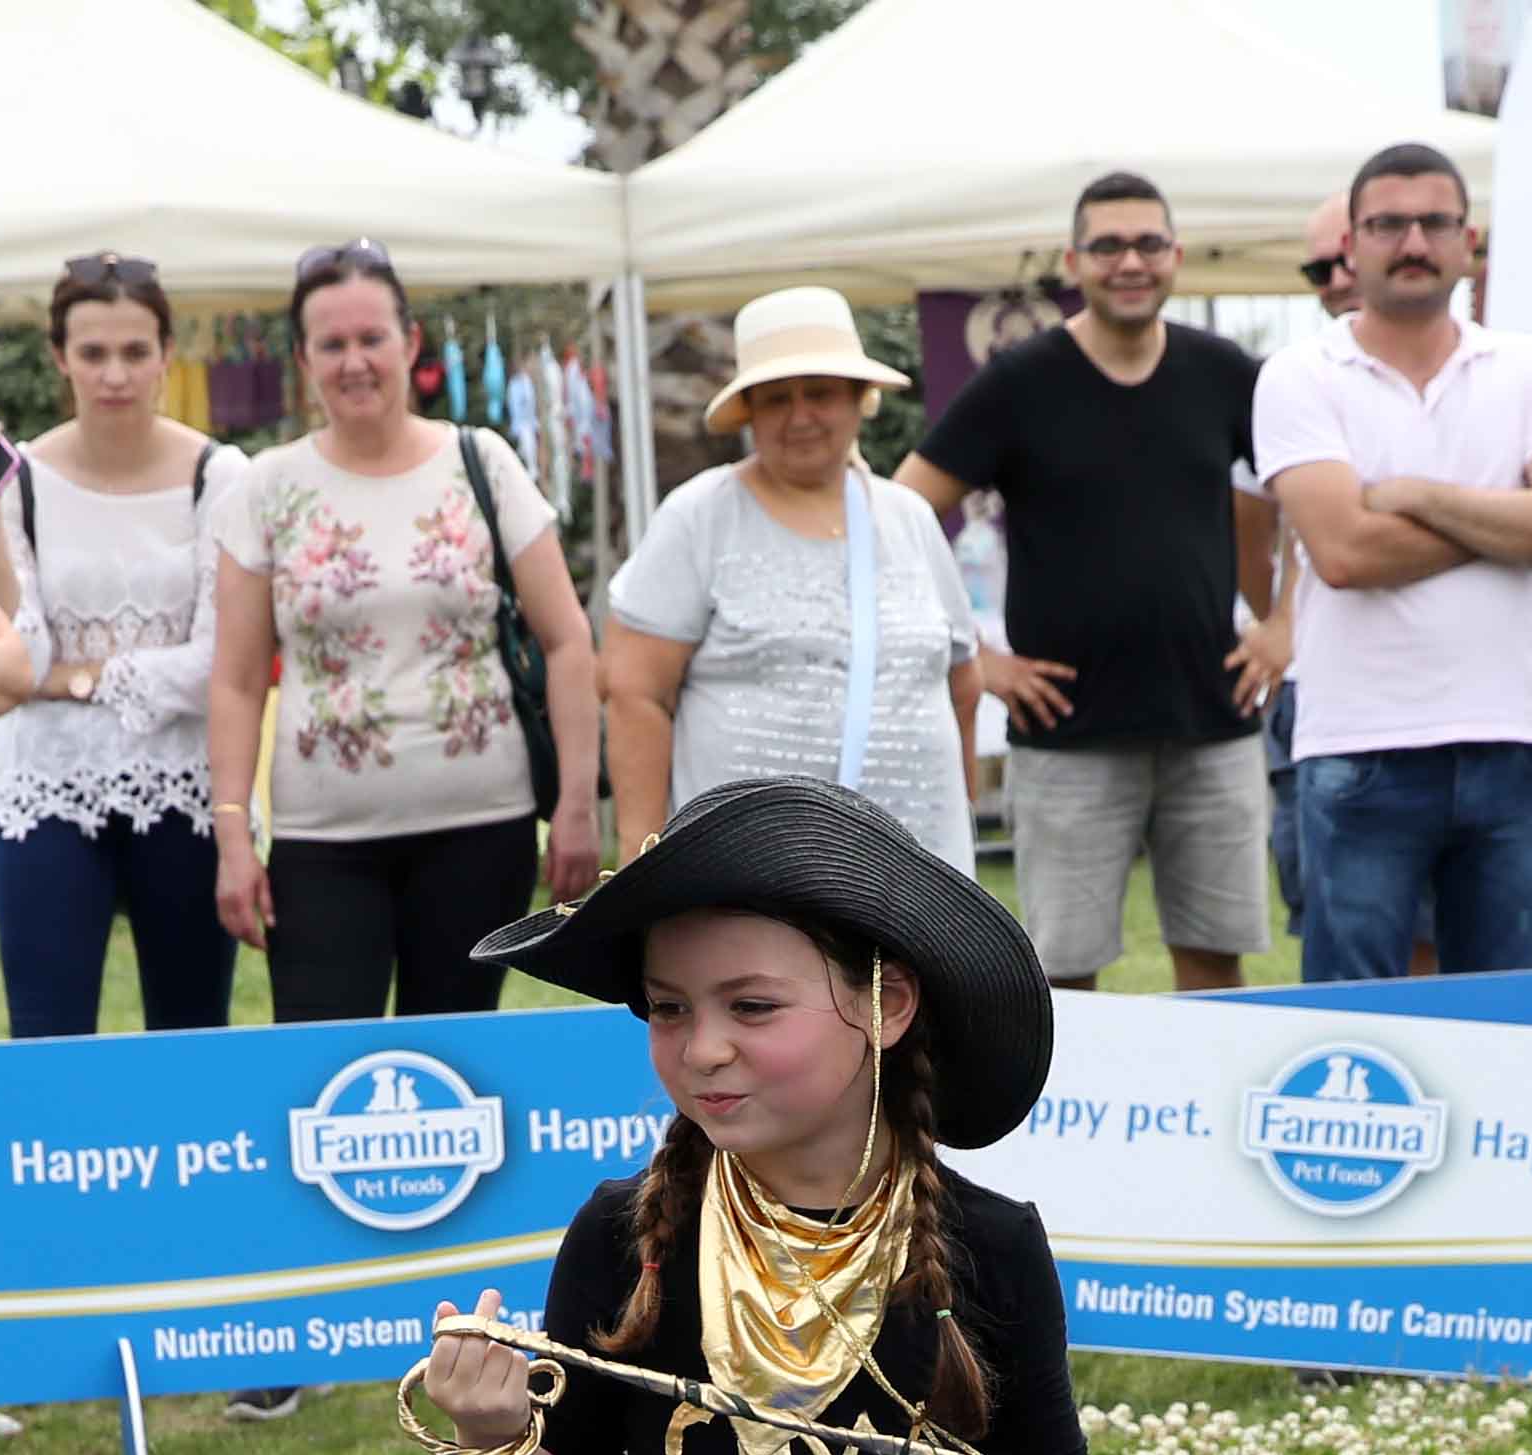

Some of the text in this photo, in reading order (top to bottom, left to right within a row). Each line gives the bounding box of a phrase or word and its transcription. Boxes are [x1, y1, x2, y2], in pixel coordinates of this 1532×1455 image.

[314, 1118, 481, 1163] Farmina
[528, 1108, 672, 1161] Happy
[1028, 1097, 1212, 1142] ppy pet.
[1260, 1103, 1424, 1153] Farmina
[11, 1130, 267, 1192] Happy pet.
[1292, 1161, 1383, 1188] Pet Foods
[355, 1174, 445, 1198] Pet Foods
[1075, 1279, 1214, 1320] Nutrition
[1223, 1289, 1338, 1331] System
[1347, 1300, 1394, 1333] for
[153, 1316, 423, 1361] Nutrition System
